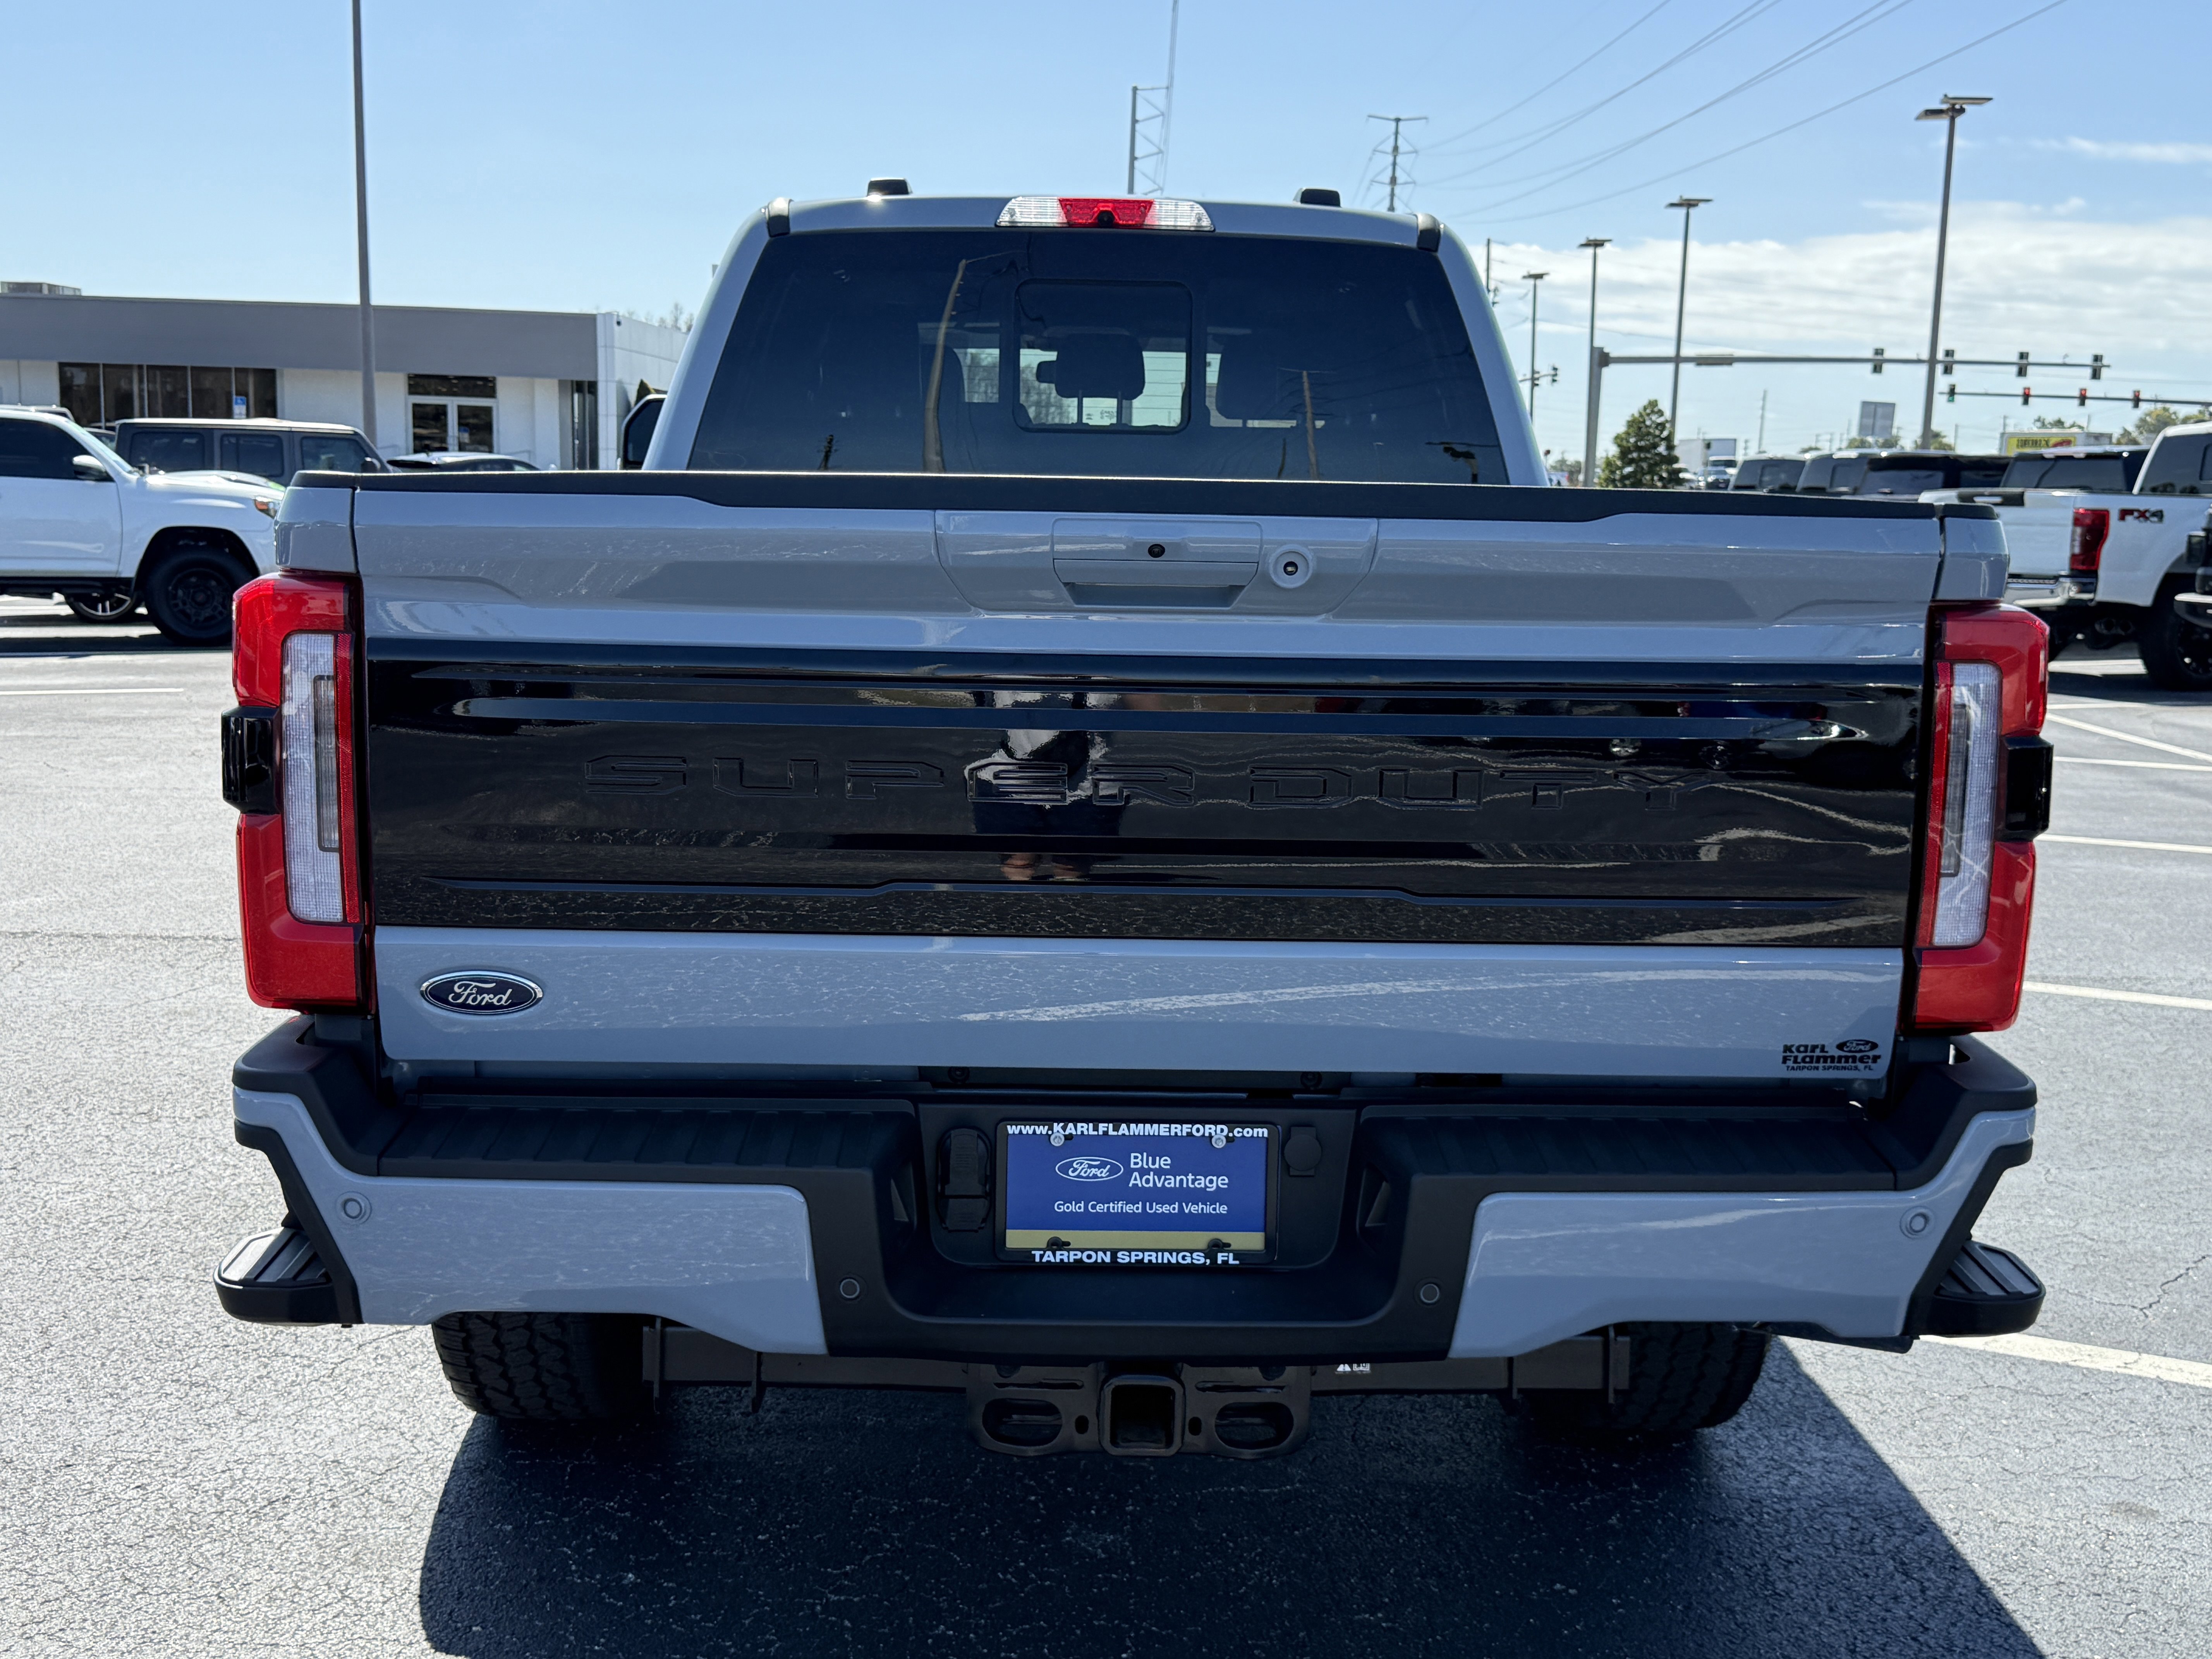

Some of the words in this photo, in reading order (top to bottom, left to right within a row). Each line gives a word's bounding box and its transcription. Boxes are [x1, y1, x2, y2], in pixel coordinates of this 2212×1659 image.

[585, 755, 1195, 806] SUPER
[1249, 764, 1712, 811] DUTY
[448, 981, 512, 1005] Ford
[1007, 1122, 1268, 1137] www.KARLFLAMMERFORD.com
[1068, 1159, 1110, 1178] Ford
[1130, 1152, 1171, 1169] Blue
[1129, 1171, 1229, 1191] Advantage
[1054, 1201, 1084, 1212] Gold
[1088, 1200, 1142, 1213] Certified
[1146, 1202, 1179, 1214] Used
[1182, 1202, 1228, 1214] Vehicle
[1032, 1250, 1111, 1263] TARPON
[1117, 1251, 1210, 1266] SPRINGS,
[1217, 1252, 1240, 1264] FL
